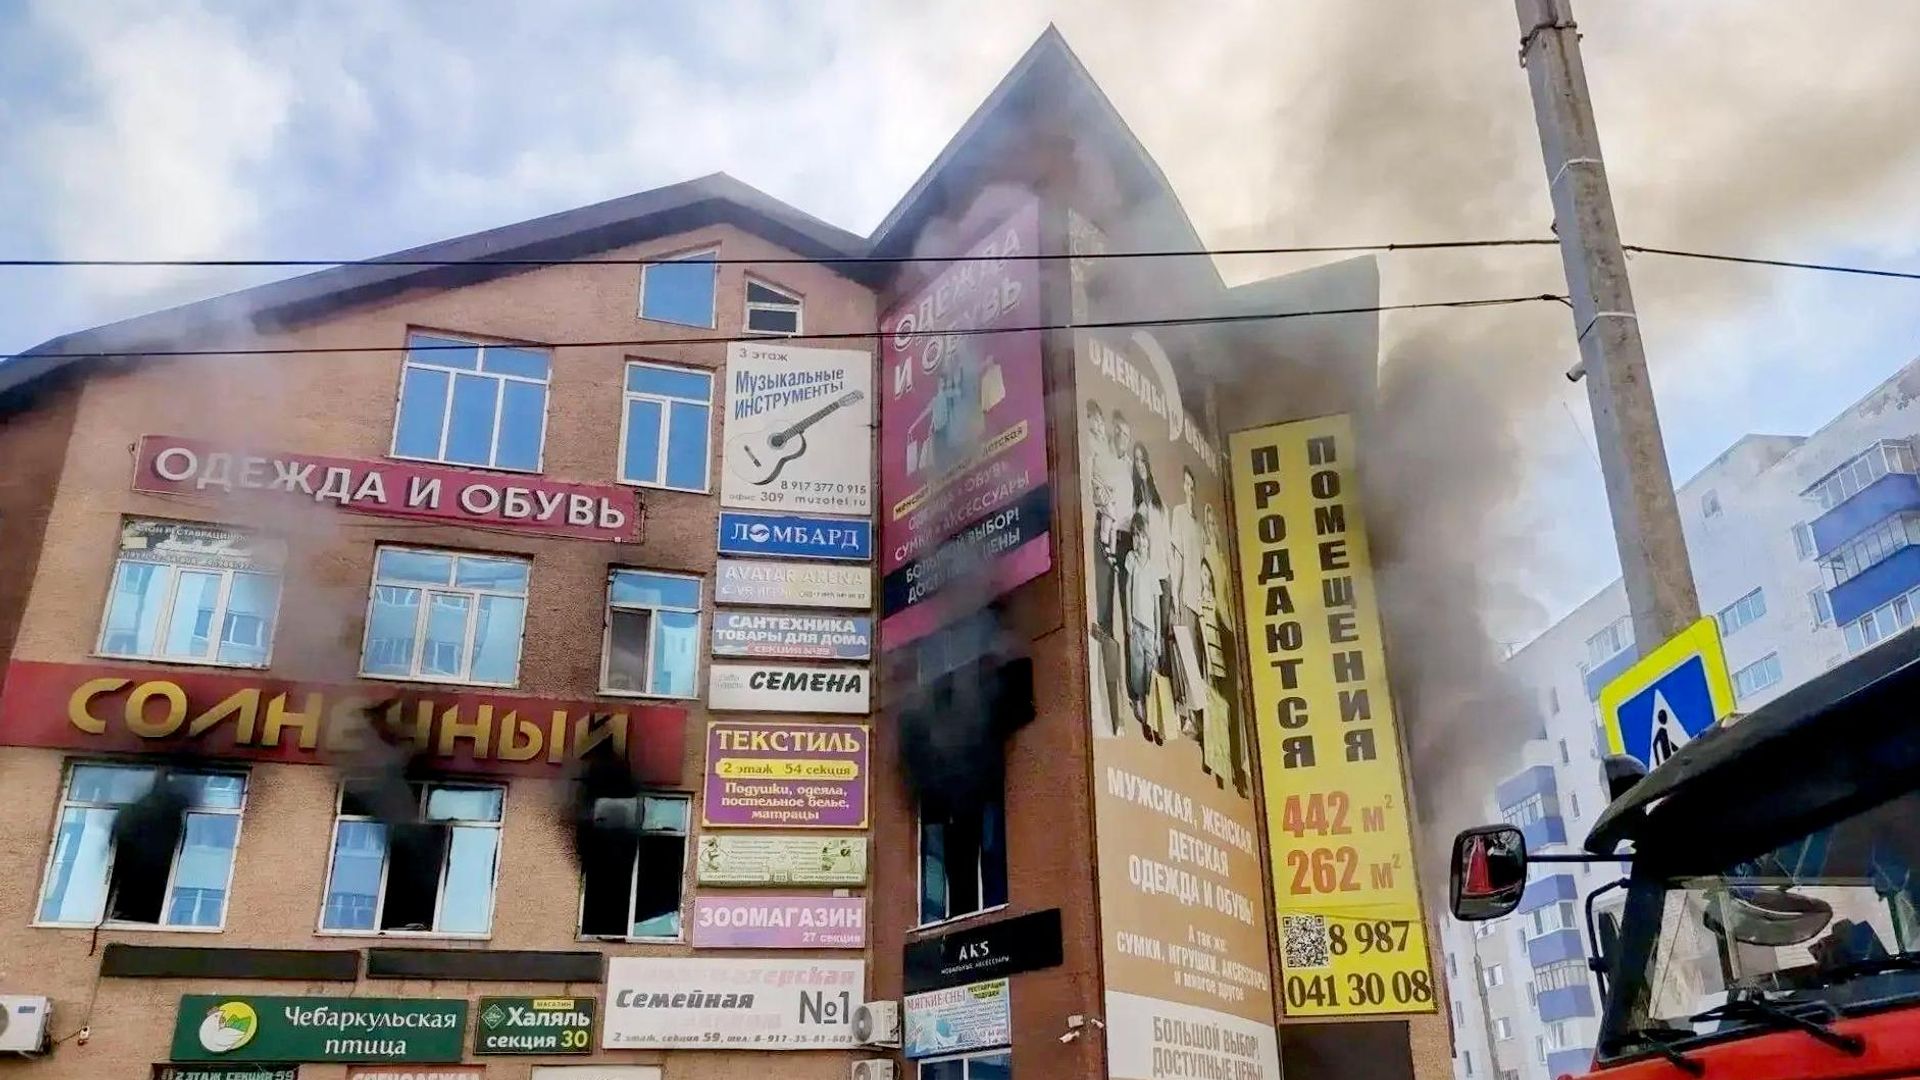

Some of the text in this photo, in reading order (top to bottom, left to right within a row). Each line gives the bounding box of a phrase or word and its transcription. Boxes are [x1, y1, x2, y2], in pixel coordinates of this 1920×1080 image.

[738, 348, 788, 361] 3 этаж
[736, 368, 844, 395] Музыкальные
[735, 381, 844, 420] ИНСТРУМЕНТЫ
[156, 447, 626, 528] ОДЕЖДА И ОБУВЬ
[761, 491, 784, 502] 309
[780, 480, 788, 490] 8
[791, 481, 811, 491] 917
[814, 483, 834, 493] 377
[847, 484, 867, 495] 915
[731, 523, 860, 550] ЛОМБАРД
[1251, 445, 1318, 769] ПРОДАЮТСЯ
[1307, 436, 1377, 762] ПОМЕЩЕНИЯ
[728, 615, 857, 633] САНТЕХНИКА
[715, 628, 868, 647] ТОВАРЫ ДЛЯ ДОМА
[749, 671, 861, 694] СЕМЕНА
[715, 730, 861, 753] ТЕКСТИЛЬ
[723, 762, 851, 776] 2 этаж 54 секция
[725, 782, 848, 797] Подушки, одеяла,
[721, 796, 805, 808] постельное
[752, 811, 820, 822] матрацы
[1107, 766, 1257, 862] МУЖСКАЯ, ЖЕНСКАЯ,
[1283, 791, 1353, 838] 442
[1167, 828, 1230, 878] ДЕТСКАЯ
[1128, 854, 1201, 907] ОДЕЖДА
[1203, 879, 1214, 909] И
[1287, 846, 1362, 896] 262
[700, 906, 862, 929] ЗООМАГАЗИН
[801, 932, 861, 946] 27 секция
[1188, 923, 1196, 944] А
[1328, 920, 1410, 956] 8 987
[958, 940, 989, 960] AKS
[1116, 930, 1166, 963] СУМКИ,
[1286, 970, 1433, 1009] 041 30 08
[506, 1006, 590, 1027] Халяль
[615, 987, 755, 1009] Семейная
[798, 990, 850, 1025] №1
[285, 1006, 458, 1032] Чебаркульская
[325, 1038, 408, 1057] птица
[486, 1030, 589, 1050] секция 30
[613, 1032, 622, 1041] 2
[1152, 1015, 1261, 1060] БОЛЬШОЙ ВЫБОР!
[1152, 1046, 1232, 1080] ДОСТУПНЫЕ
